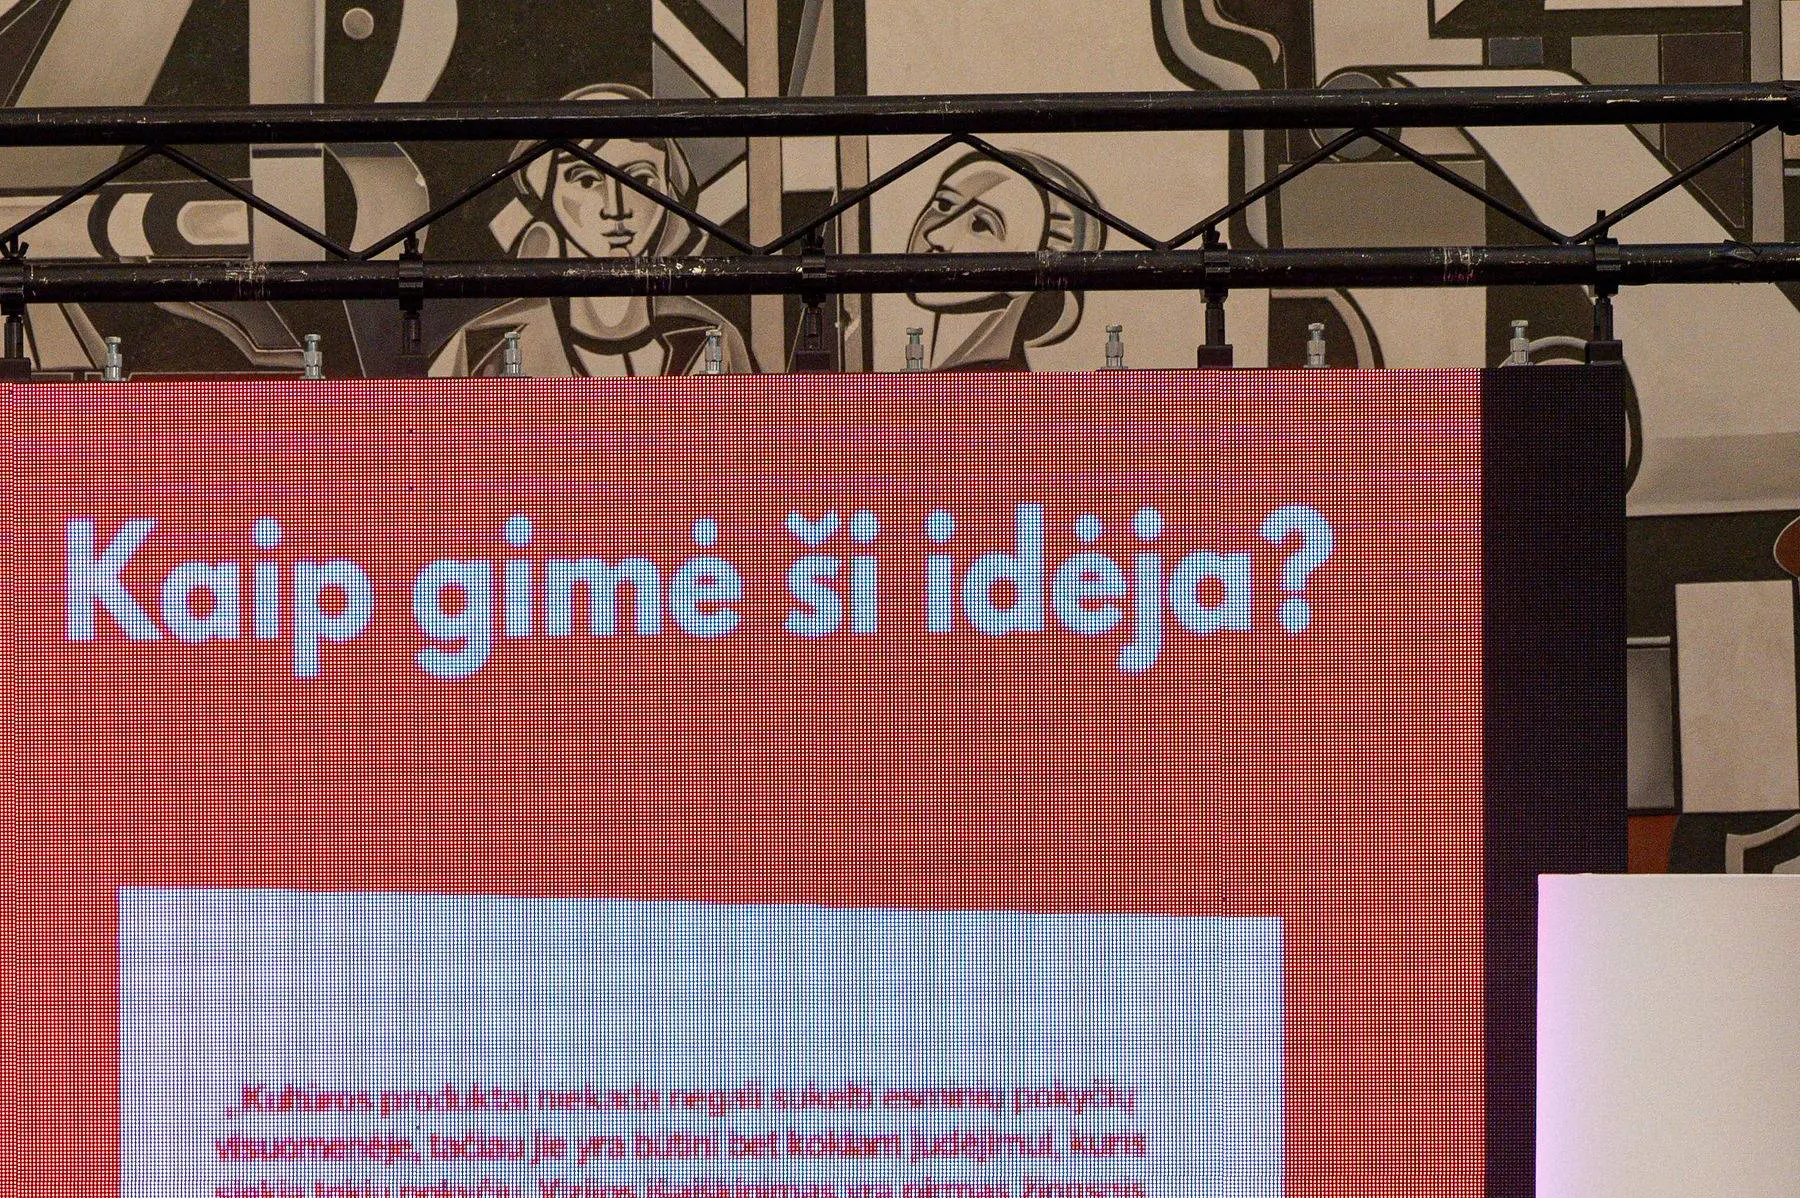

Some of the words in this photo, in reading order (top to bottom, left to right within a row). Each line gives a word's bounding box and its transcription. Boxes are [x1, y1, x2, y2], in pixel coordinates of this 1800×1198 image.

[64, 516, 374, 679] Kaip
[410, 514, 746, 678] gimė
[785, 507, 882, 639] ši
[924, 502, 1334, 674] idėja?
[379, 1083, 529, 1117] produktai
[536, 1086, 661, 1111] niekada
[670, 1083, 763, 1118] negali
[772, 1082, 873, 1110] sukelti
[881, 1086, 1003, 1115] esminių
[1013, 1080, 1135, 1116] pokyčių
[214, 1133, 421, 1166] visuomenėje,
[430, 1130, 525, 1161] tačiau
[529, 1134, 567, 1166] jie
[577, 1137, 626, 1166] yra
[634, 1130, 718, 1159] būtini
[728, 1132, 779, 1159] bet
[787, 1130, 902, 1158] kokiam
[911, 1130, 1060, 1163] judėjimui,
[1069, 1131, 1146, 1158] kuris
